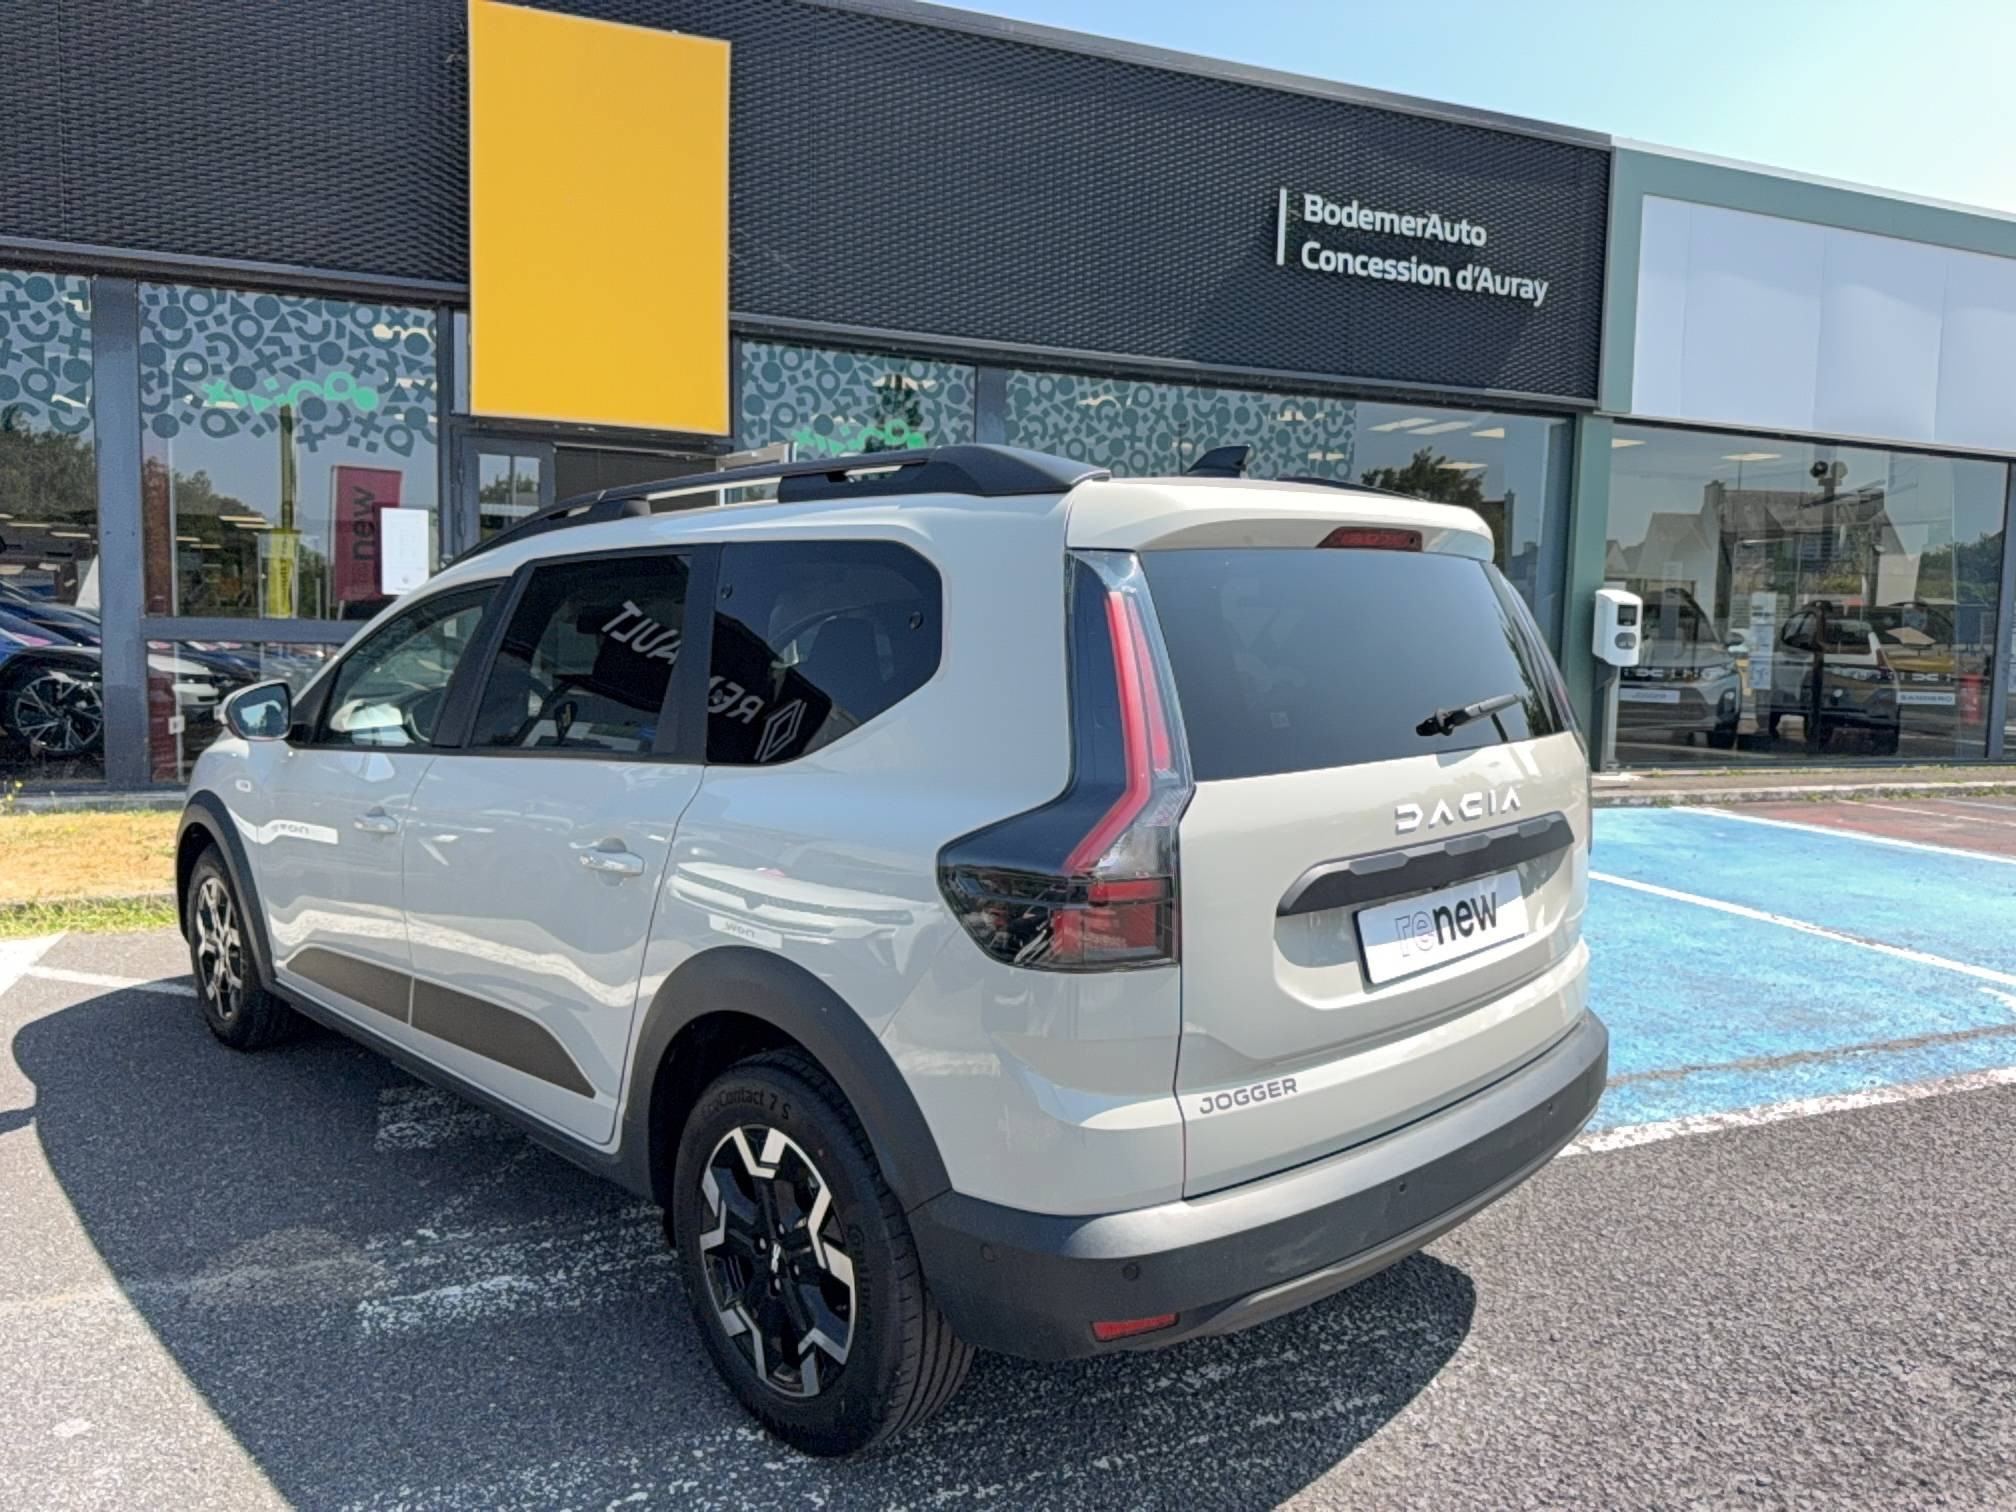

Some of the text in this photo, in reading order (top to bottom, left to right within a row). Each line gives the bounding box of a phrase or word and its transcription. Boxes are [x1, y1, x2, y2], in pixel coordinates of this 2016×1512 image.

[1303, 193, 1487, 247] BodemerAuto
[1301, 241, 1549, 307] Concession d'Auray
[1394, 786, 1522, 834] DACIA
[1394, 891, 1498, 958] renew
[769, 1092, 779, 1110] 7
[782, 1102, 792, 1120] S
[1200, 1078, 1298, 1114] JOGGER
